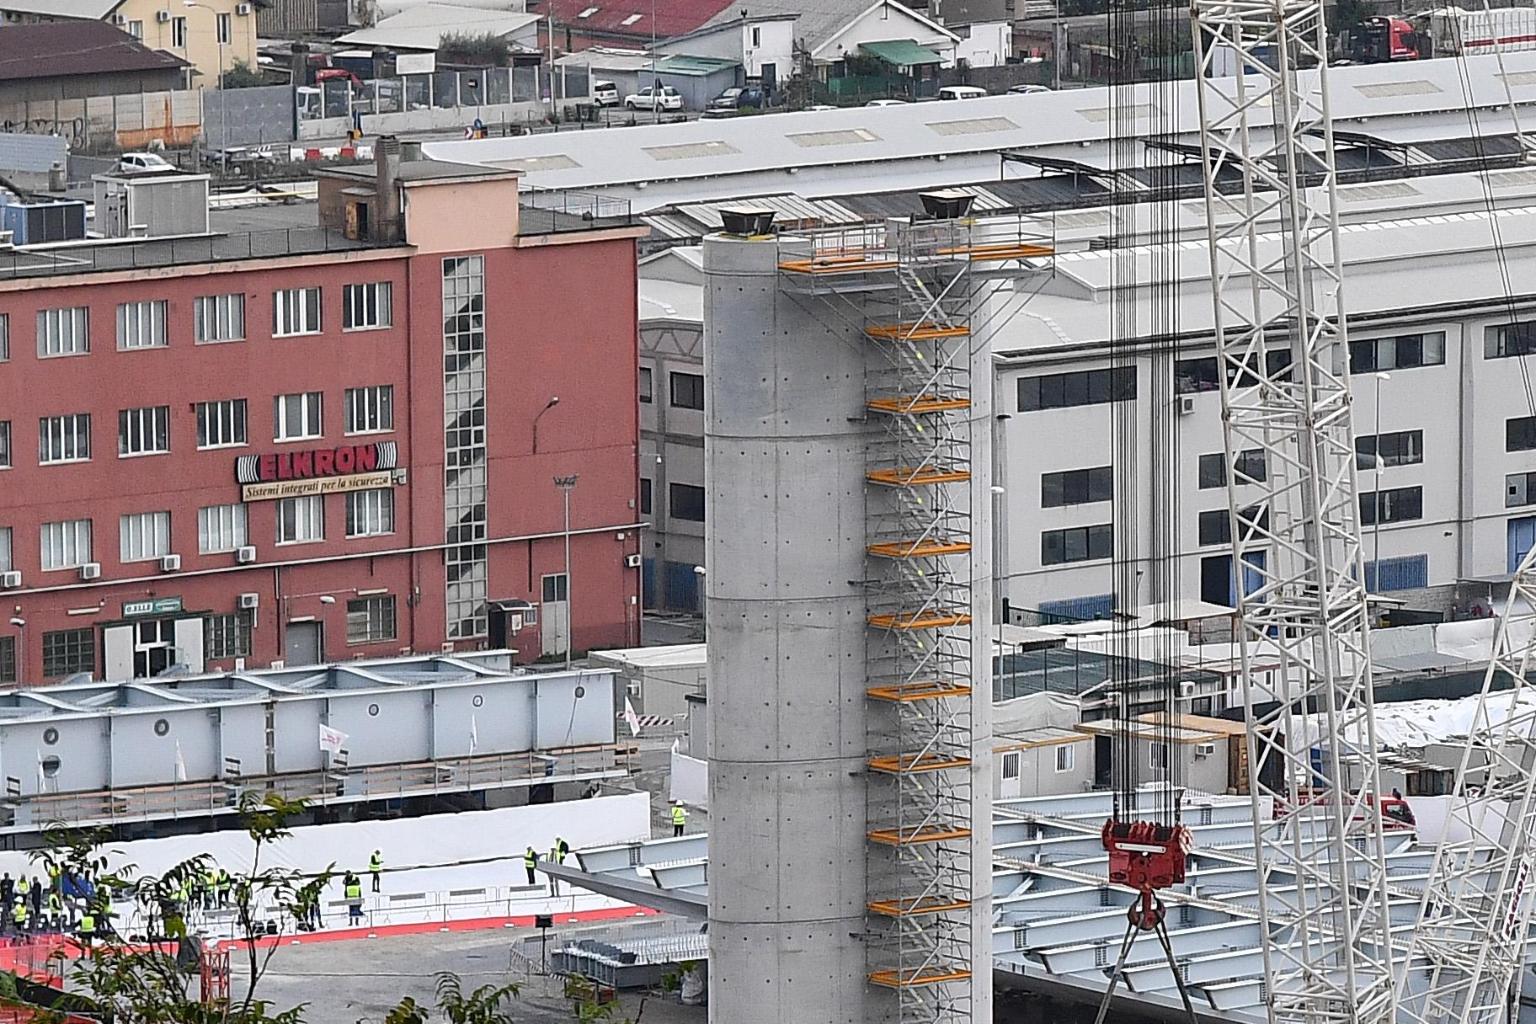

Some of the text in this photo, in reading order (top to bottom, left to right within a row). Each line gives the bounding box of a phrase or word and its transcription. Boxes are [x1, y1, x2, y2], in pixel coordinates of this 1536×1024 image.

[260, 445, 376, 480] ELKRON
[245, 476, 388, 497] Sistemi integrati per la sicurezza
